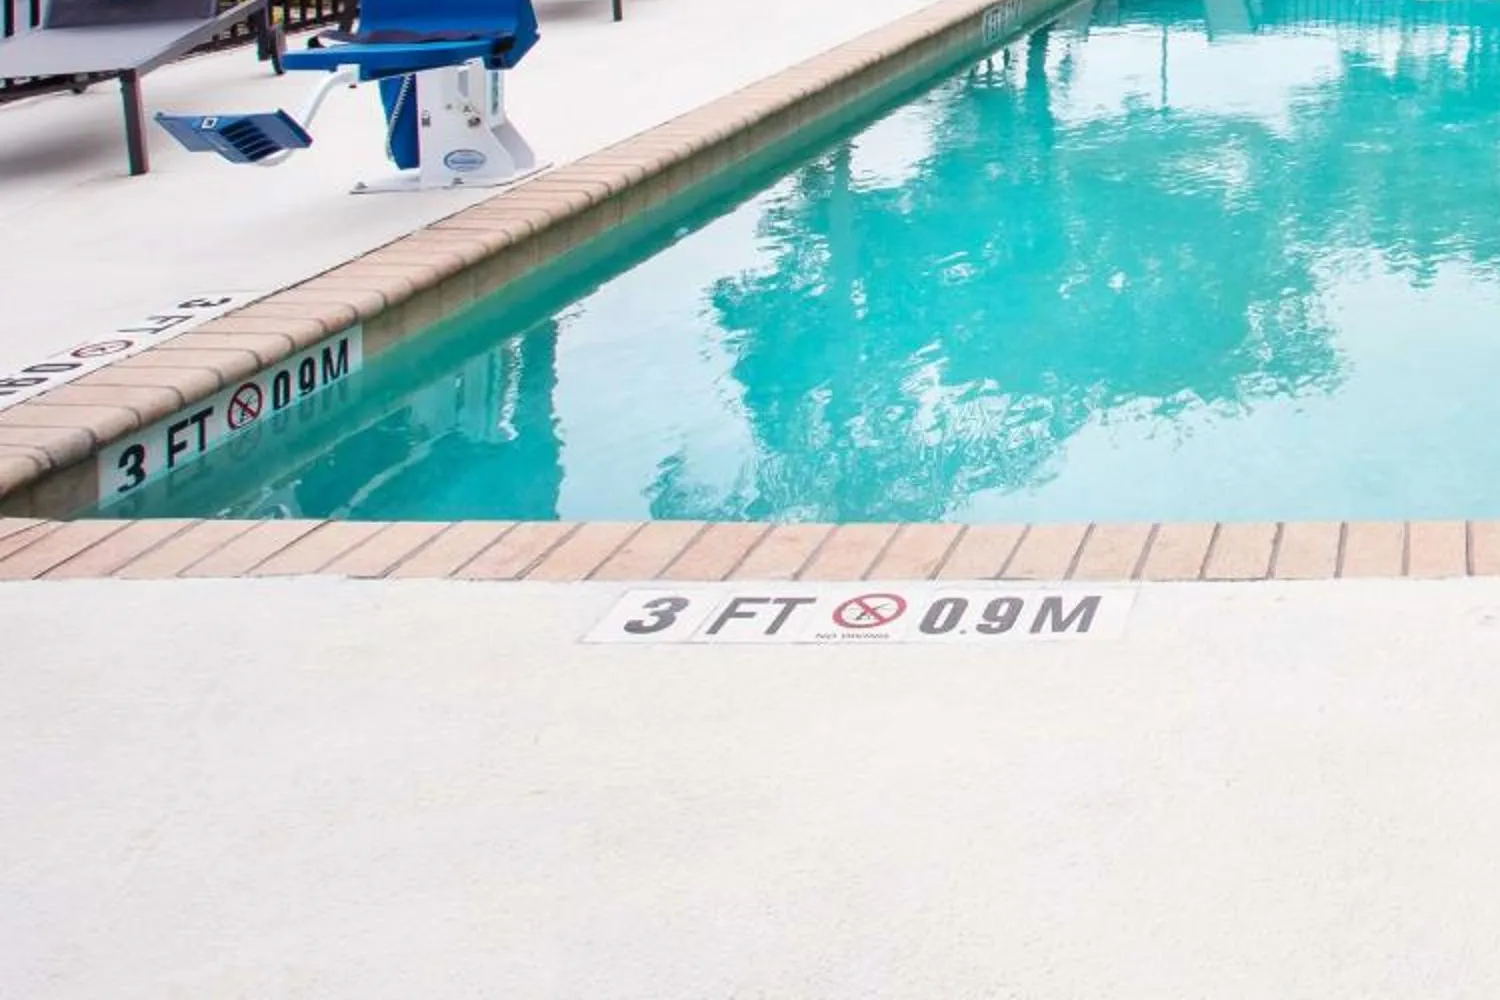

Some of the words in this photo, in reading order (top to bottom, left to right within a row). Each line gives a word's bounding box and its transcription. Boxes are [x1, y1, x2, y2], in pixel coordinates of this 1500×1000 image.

[116, 315, 194, 335] FT
[117, 443, 147, 493] 3
[167, 405, 215, 469] FT
[623, 596, 690, 635] 3
[705, 596, 818, 636] FT
[918, 595, 1103, 636] 0.9M
